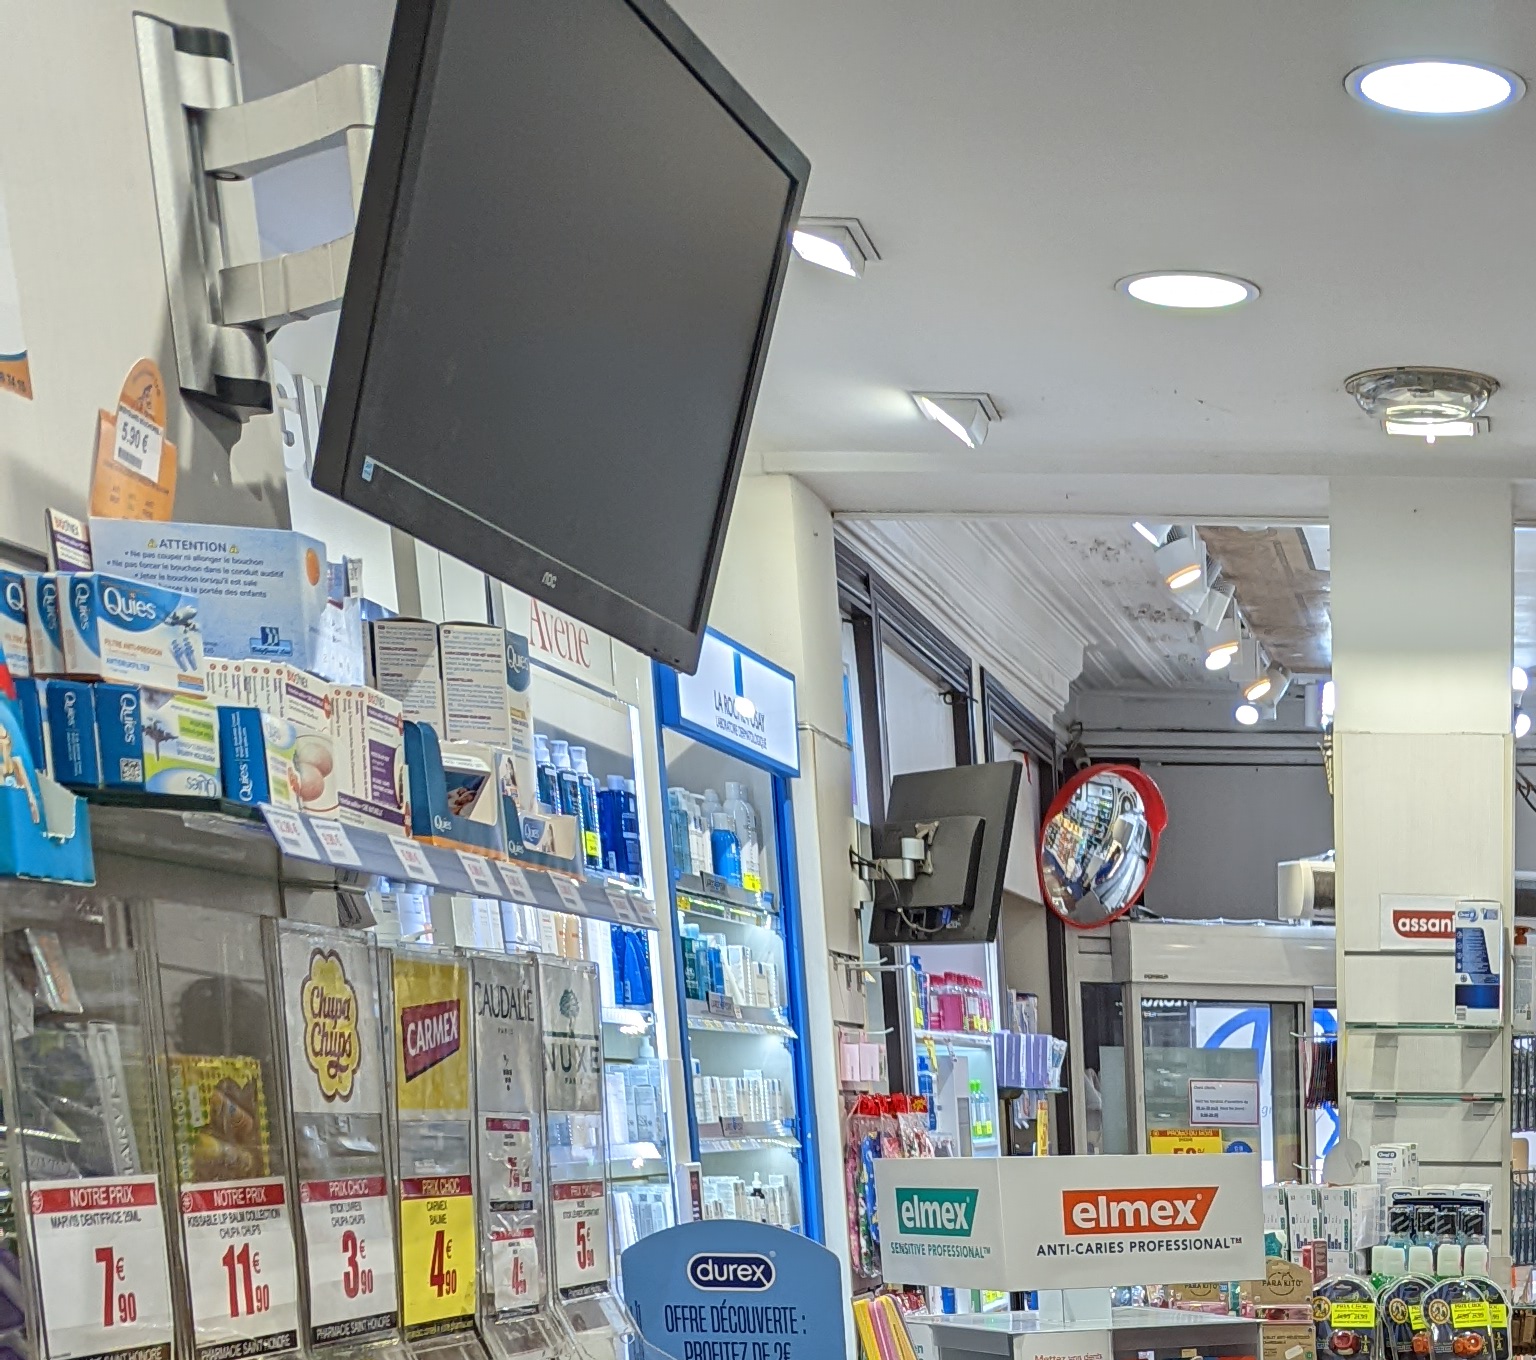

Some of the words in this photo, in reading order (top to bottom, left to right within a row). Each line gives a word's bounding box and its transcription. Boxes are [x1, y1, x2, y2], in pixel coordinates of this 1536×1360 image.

[159, 539, 227, 552] ATTENTION
[232, 557, 263, 566] bouchon
[75, 583, 90, 631] Quies
[104, 587, 156, 622] Quies
[120, 693, 136, 745] Quies
[239, 763, 253, 802] Quies
[310, 986, 351, 1029] Chupa
[310, 1022, 352, 1079] Chups
[407, 1010, 459, 1057] CARMEX
[69, 1188, 108, 1207] NOTRE
[109, 1186, 134, 1206] PRIX
[213, 1188, 244, 1207] NOTRE
[245, 1186, 266, 1205] PRIX
[329, 1182, 346, 1196] PRIX
[347, 1180, 368, 1195] CHOC
[902, 1195, 969, 1231] elmex
[1073, 1195, 1199, 1230] elmex
[890, 1241, 927, 1257] SENSITIVE
[1036, 1241, 1125, 1257] ANTI-CARIES
[696, 1258, 769, 1287] durex
[664, 1304, 707, 1333] OFFRE
[710, 1299, 798, 1335] DÉCOUVERTE
